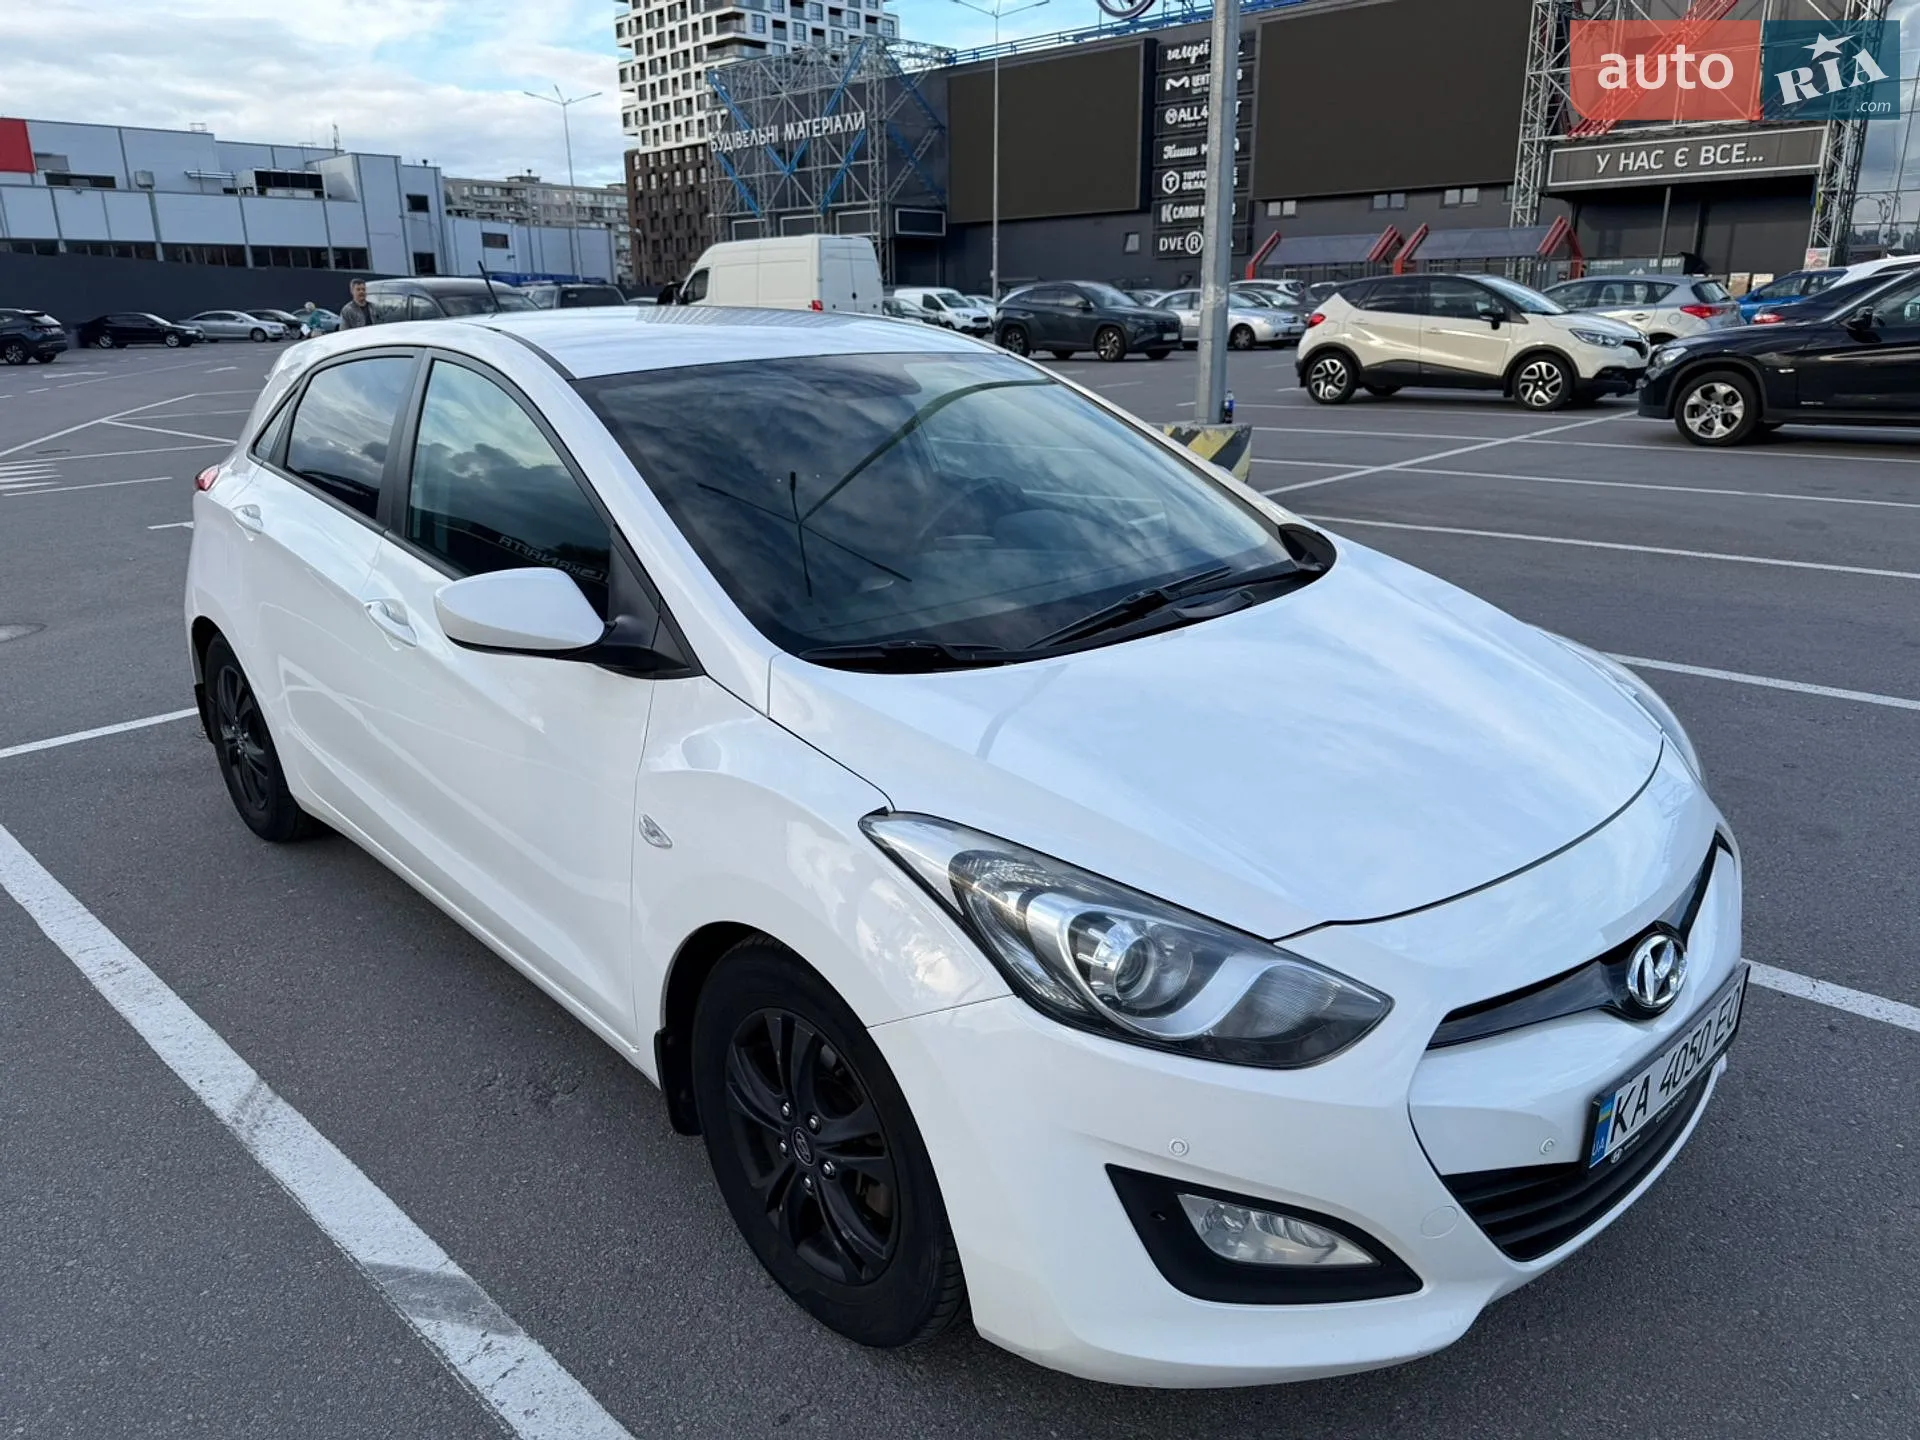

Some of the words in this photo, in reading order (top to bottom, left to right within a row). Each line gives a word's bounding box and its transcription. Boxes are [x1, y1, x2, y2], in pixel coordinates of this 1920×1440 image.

[711, 125, 779, 153] БУДІВЕЛЬНІ
[784, 111, 866, 142] МАТЕРІАЛИ
[1596, 153, 1610, 173] У
[1618, 149, 1665, 172] НАС
[1674, 147, 1690, 168] Є
[1699, 143, 1765, 166] ВСЕ...
[1610, 1074, 1651, 1143] KA
[1659, 1019, 1712, 1096] 4050
